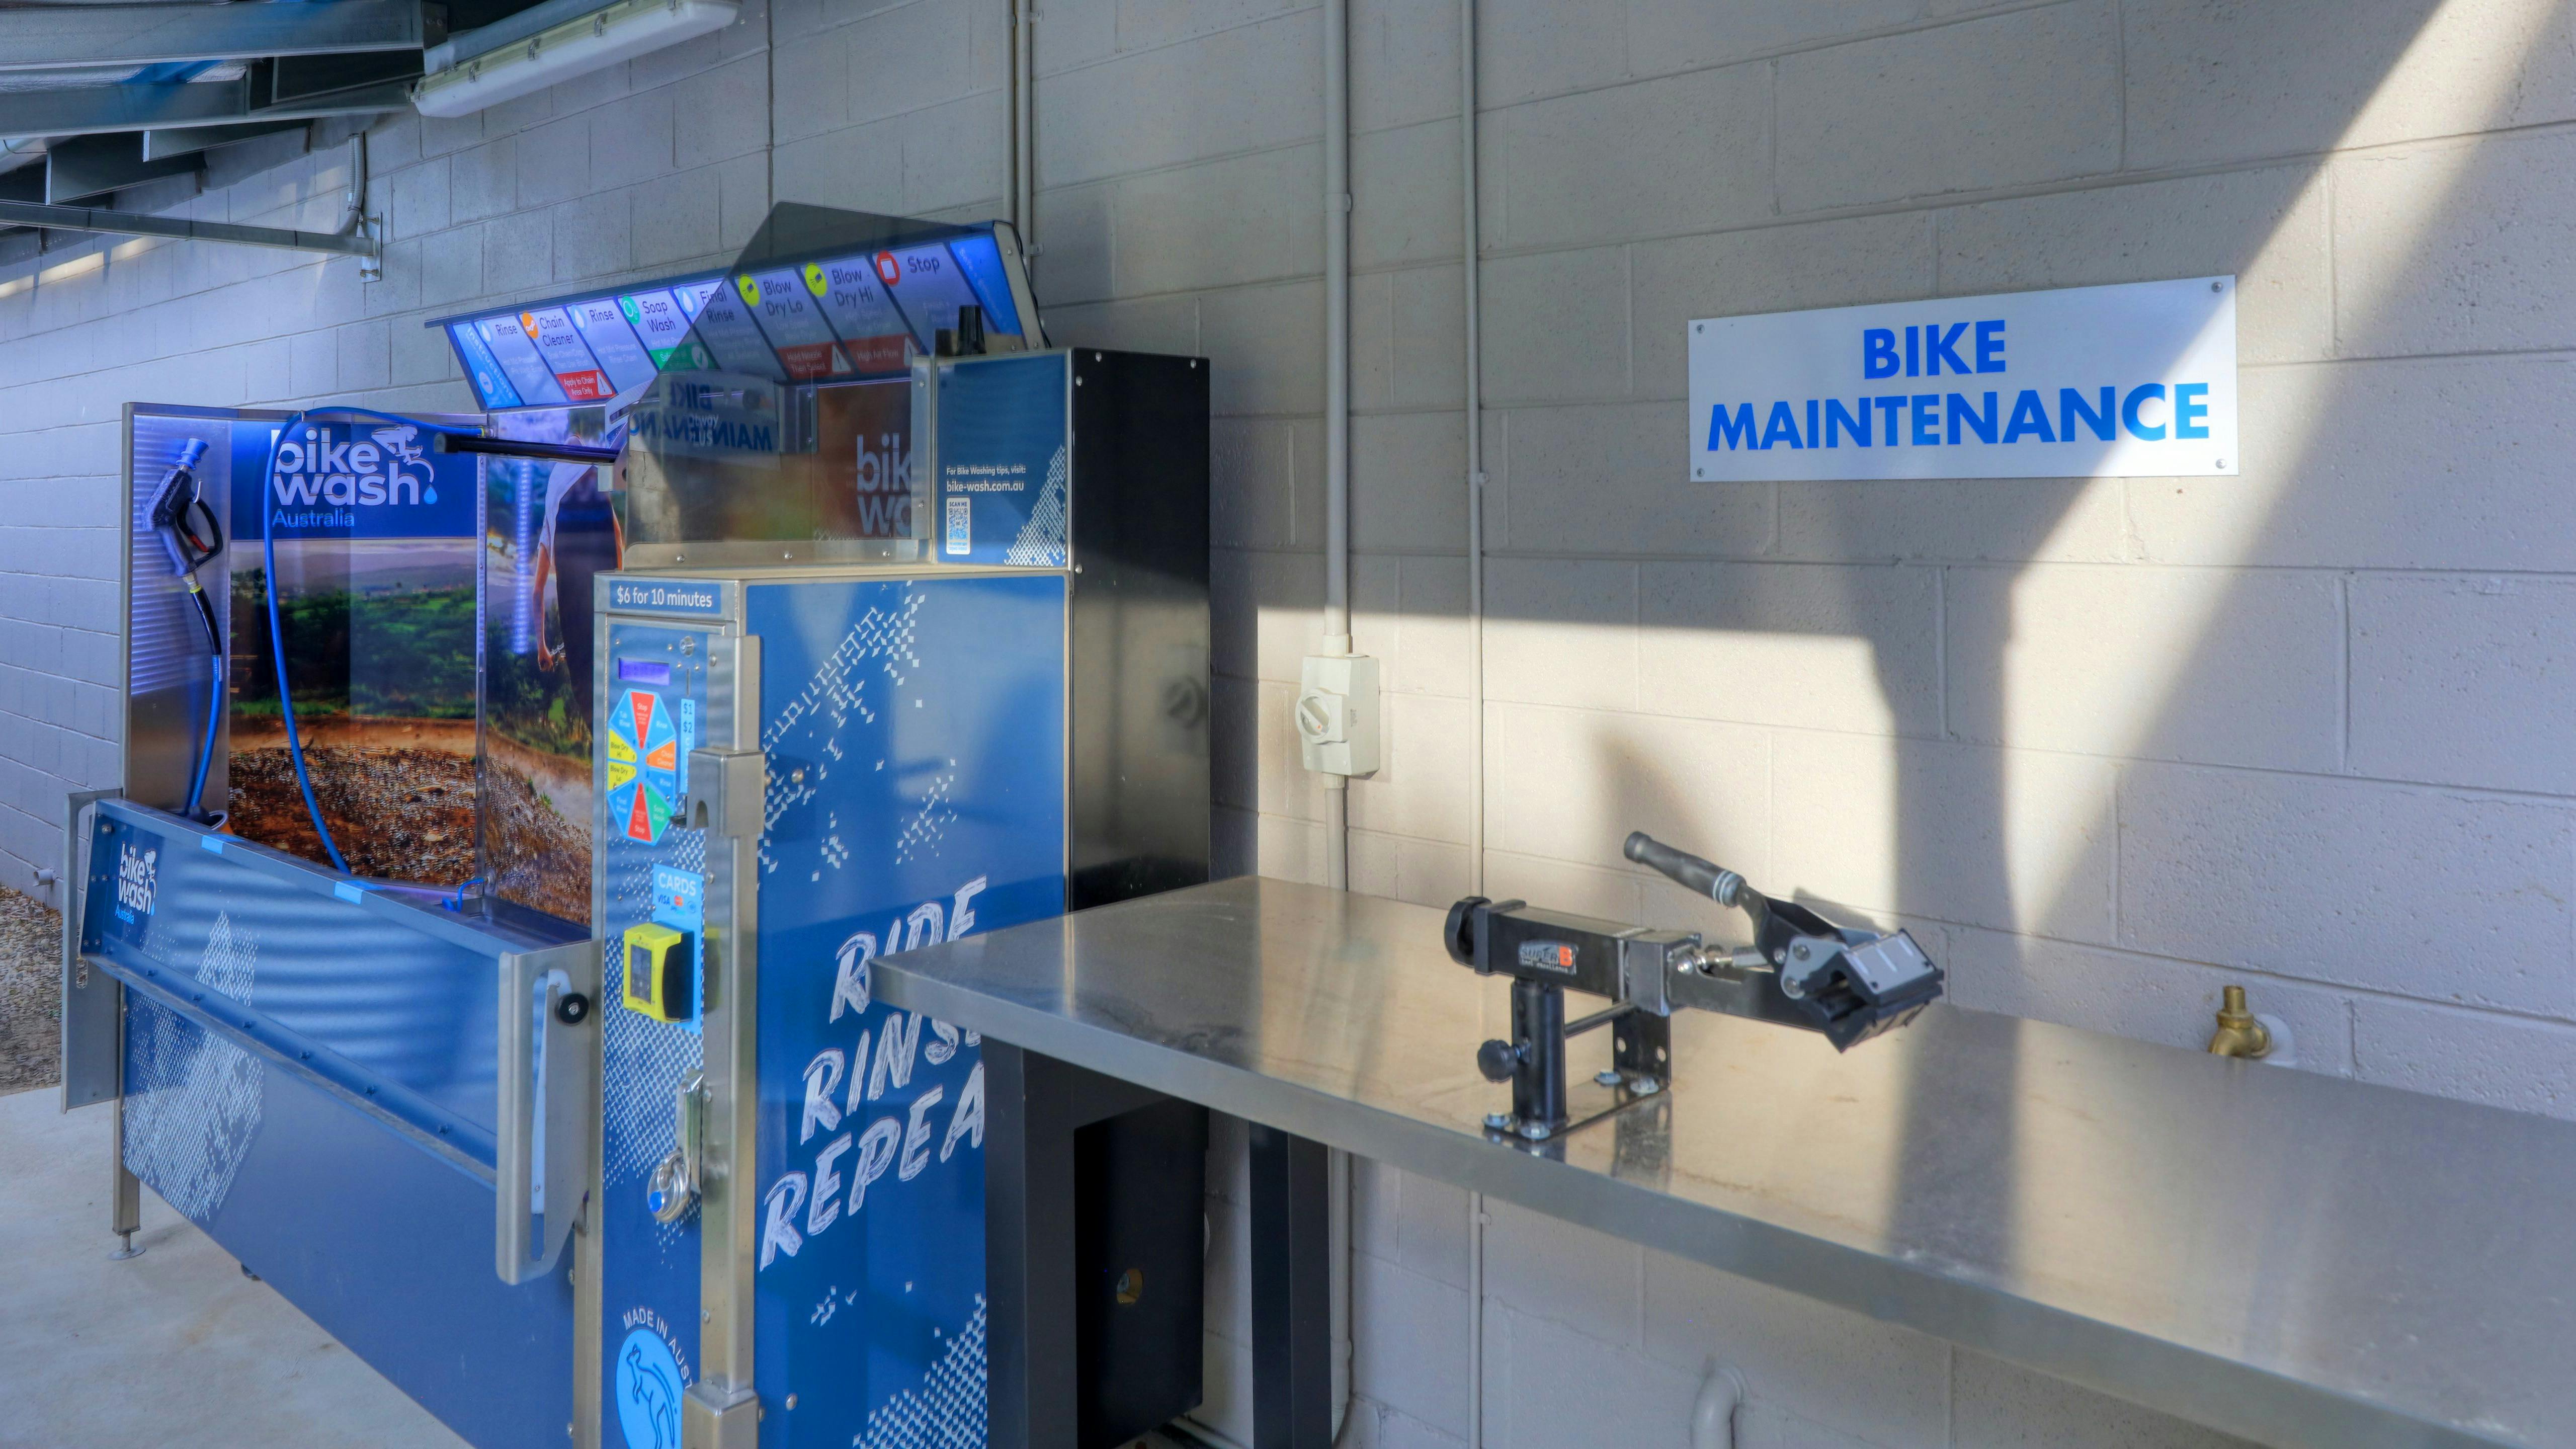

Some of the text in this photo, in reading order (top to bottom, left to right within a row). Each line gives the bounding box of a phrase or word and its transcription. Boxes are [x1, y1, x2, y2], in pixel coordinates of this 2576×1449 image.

[908, 256, 939, 274] Stop
[832, 269, 862, 285] Blow
[764, 279, 791, 295] Blow
[700, 287, 727, 305] Final
[835, 286, 874, 309] Dry Hi
[589, 309, 614, 323] Rinse
[642, 301, 668, 314] Soap
[707, 308, 734, 324] Rinse
[766, 299, 803, 318] Dry Lo
[495, 324, 518, 337] Rinse
[539, 315, 564, 330] Chain
[647, 317, 676, 332] Wash
[543, 334, 574, 347] Cleaner
[1864, 319, 2006, 379] BIKE
[467, 328, 513, 399] Instructions
[564, 377, 576, 387] Apply
[583, 377, 595, 385] Chain
[572, 387, 581, 395] Area
[1707, 382, 2209, 451] MAINTENANCE
[271, 428, 380, 474] bike
[947, 465, 1026, 476] For Bike Washing tips, visit:
[274, 460, 419, 506] wash
[947, 479, 1024, 492] bike-wash.com.au
[272, 508, 355, 527] Australia
[617, 586, 712, 607] $6 for 10 minutes
[637, 703, 648, 712] Stop
[684, 703, 692, 714] $1
[683, 721, 692, 733] $2
[120, 843, 145, 885] bike
[658, 872, 696, 897] CARDS
[119, 877, 151, 914] wash
[657, 894, 670, 905] VISA
[115, 904, 135, 924] Australia
[800, 1012, 982, 1146] RINS
[623, 1308, 654, 1330] MADE
[656, 1317, 668, 1339] IN
